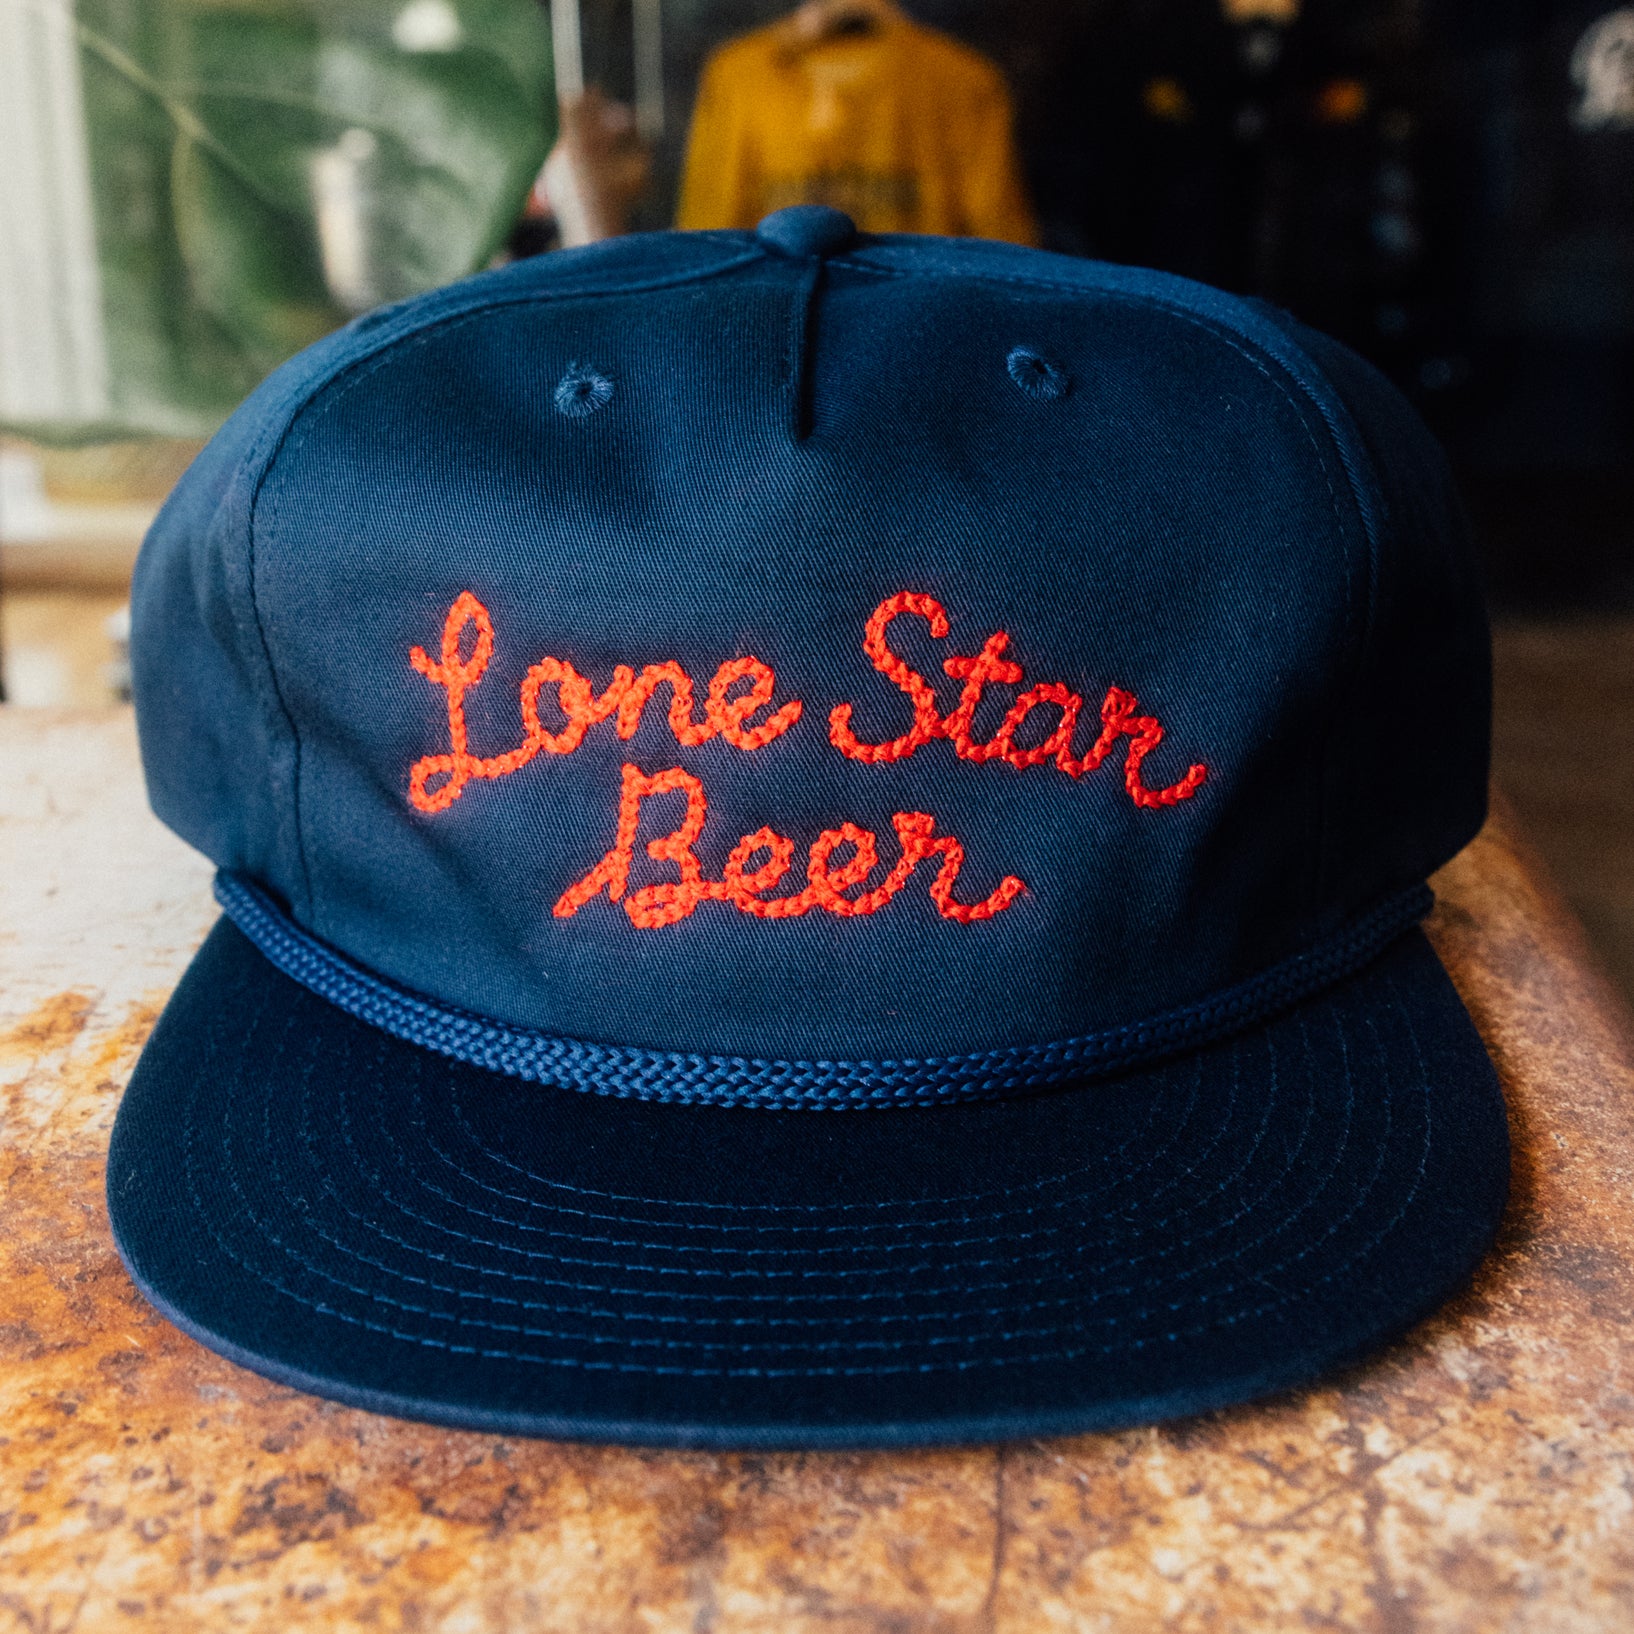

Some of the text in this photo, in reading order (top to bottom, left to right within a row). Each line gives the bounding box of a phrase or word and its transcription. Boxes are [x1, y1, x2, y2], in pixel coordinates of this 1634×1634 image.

[409, 589, 1206, 814] Lone Star
[553, 763, 1027, 930] Beer
